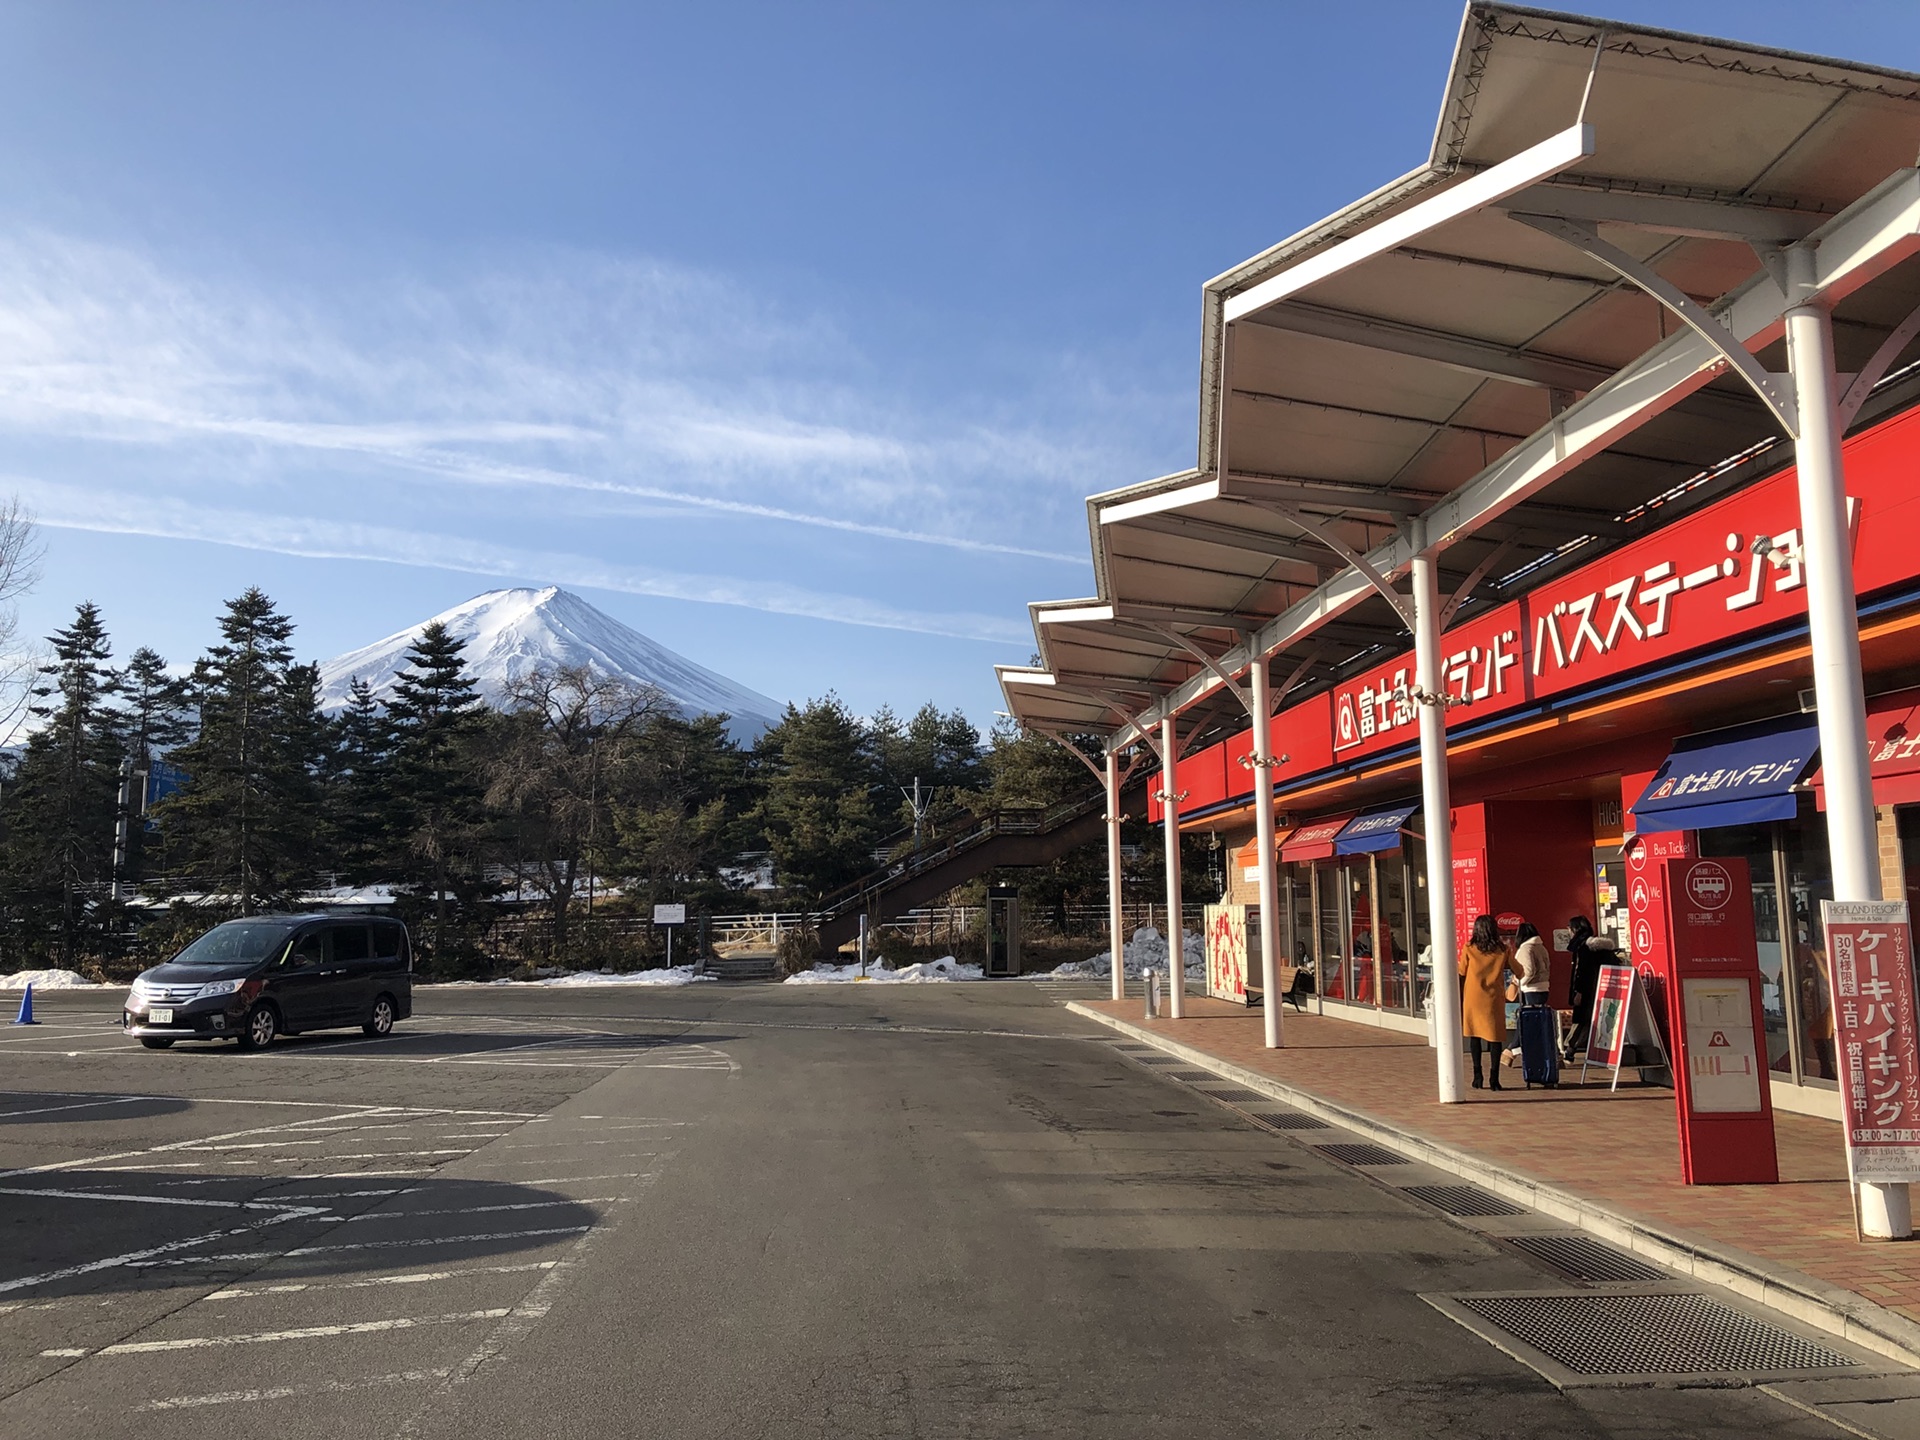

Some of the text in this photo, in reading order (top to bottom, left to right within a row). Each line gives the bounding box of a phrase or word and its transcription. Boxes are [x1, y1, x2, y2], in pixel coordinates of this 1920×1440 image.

[1673, 758, 1800, 796] 富士急ハイランド
[1653, 843, 1667, 855] Bus
[1830, 904, 1902, 914] HIGHLAND RESORT
[1836, 937, 1855, 995] 30名様限定
[1857, 929, 1905, 1126] ケーキバイキング
